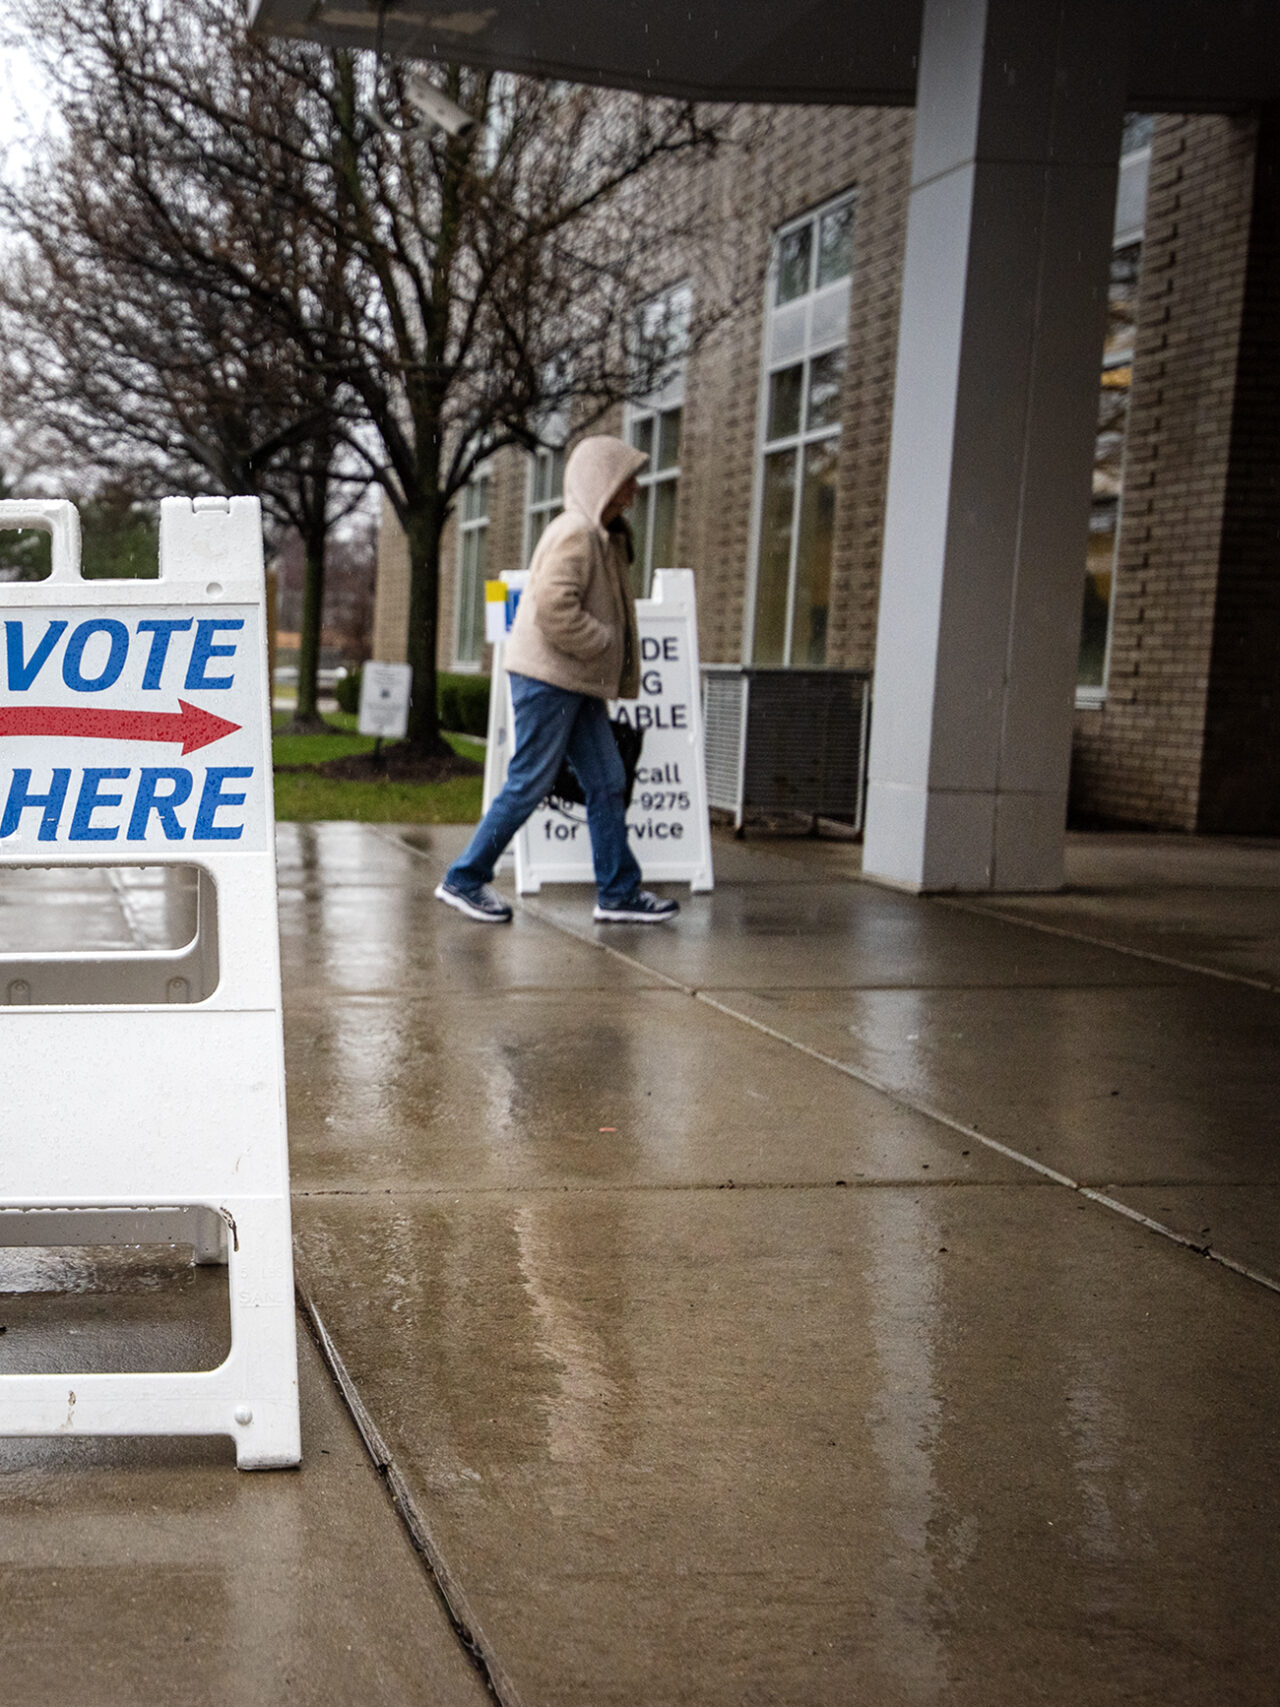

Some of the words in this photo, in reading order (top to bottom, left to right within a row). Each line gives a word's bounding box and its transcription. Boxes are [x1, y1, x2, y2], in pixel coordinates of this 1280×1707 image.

[3, 616, 245, 692] VOTE
[640, 636, 679, 662] DE
[641, 669, 663, 696] G
[615, 704, 687, 730] ABLE
[634, 762, 681, 784] call
[631, 791, 691, 811] -9275
[544, 819, 580, 841] for
[626, 817, 684, 840] rvice
